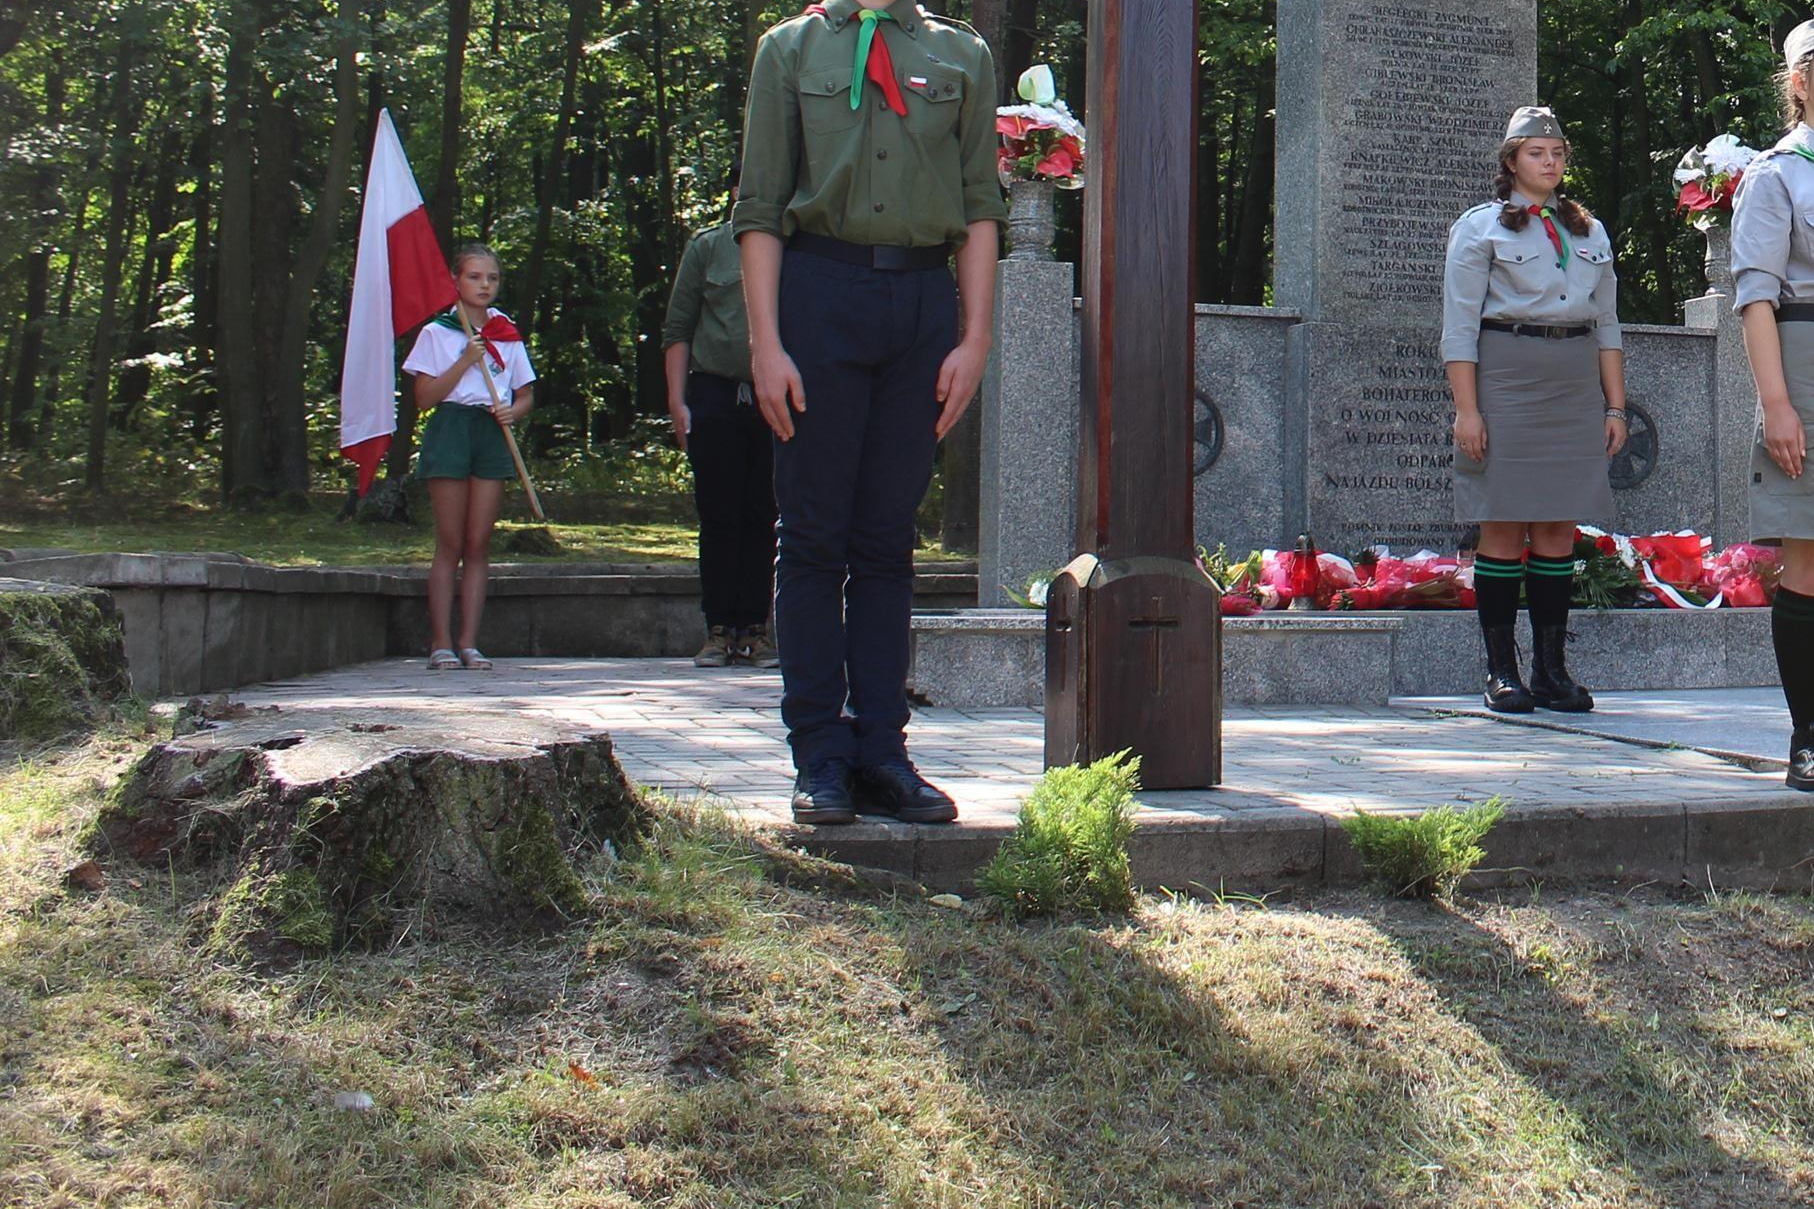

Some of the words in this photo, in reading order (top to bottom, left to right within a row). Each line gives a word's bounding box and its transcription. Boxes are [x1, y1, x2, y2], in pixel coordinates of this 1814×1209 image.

[1435, 12, 1490, 27] ZYGMUNT
[1451, 34, 1515, 51] ALEKSANDER
[1355, 109, 1423, 125] GRABOWSKI
[1363, 174, 1426, 189] MAKOWSKI
[1396, 343, 1440, 359] ROKU
[1378, 365, 1437, 380] MIASTO
[1341, 409, 1352, 423] O
[1346, 431, 1359, 445] W
[1326, 472, 1399, 490] NAJAZDU
